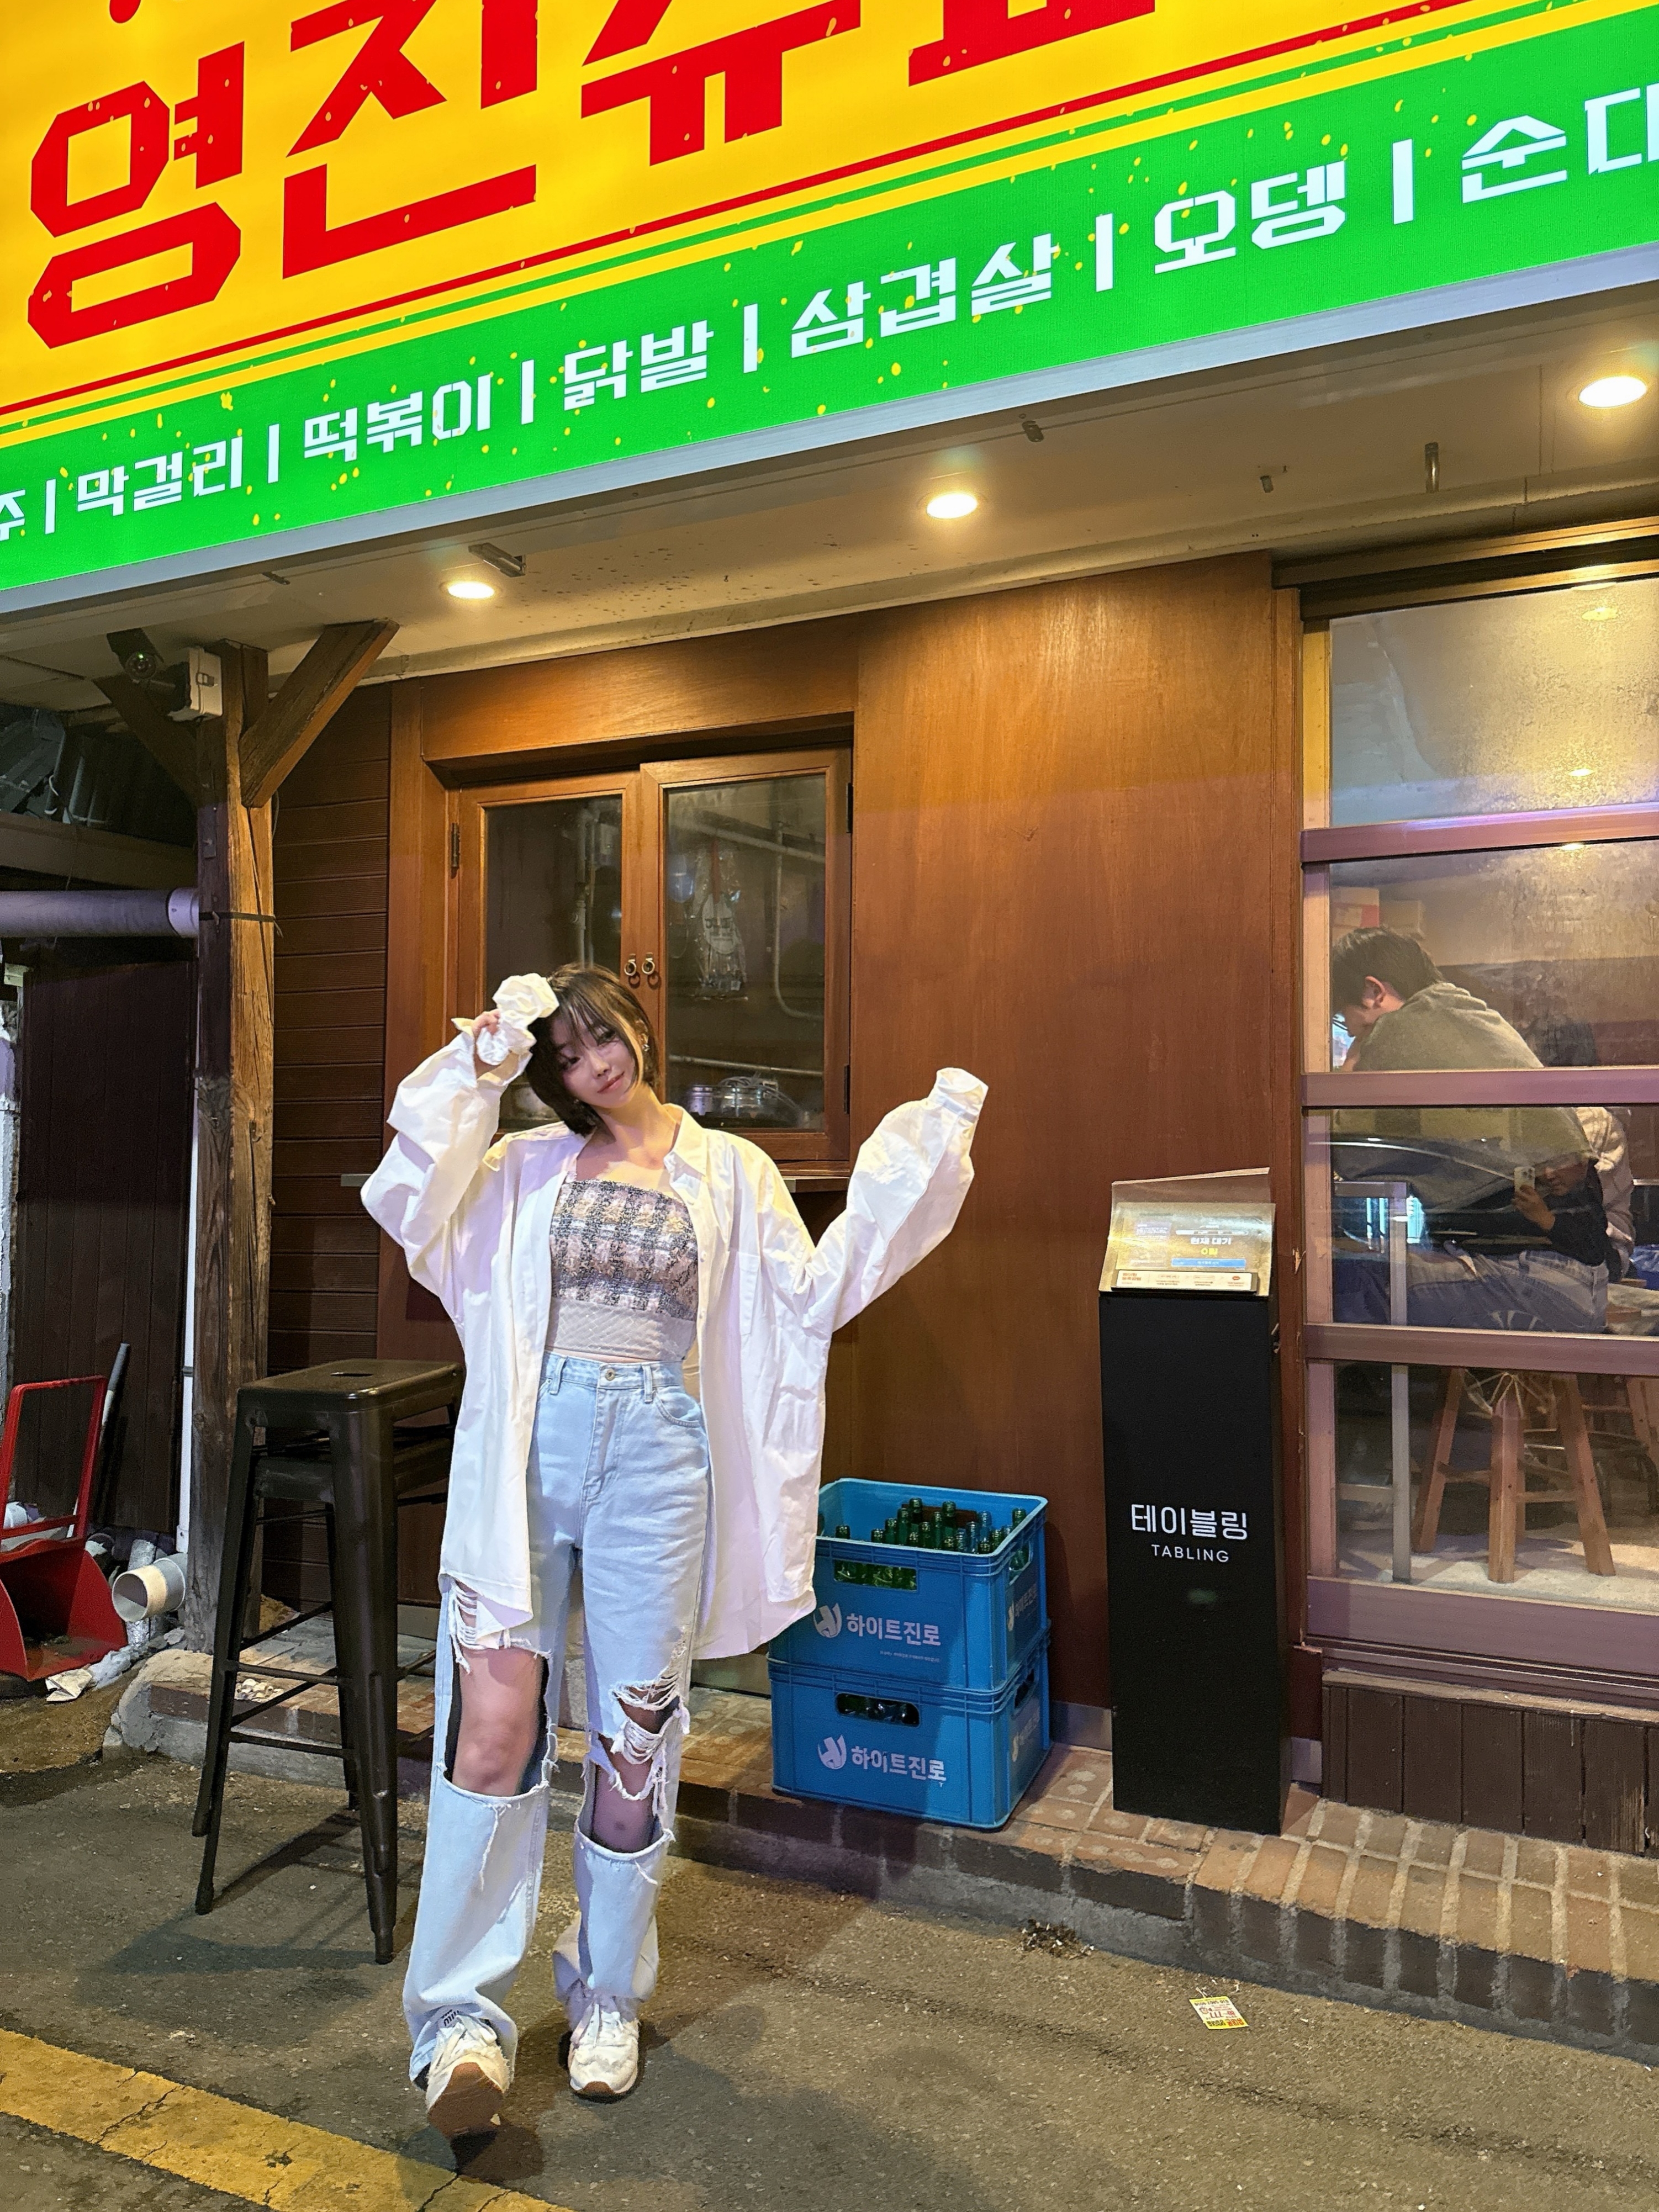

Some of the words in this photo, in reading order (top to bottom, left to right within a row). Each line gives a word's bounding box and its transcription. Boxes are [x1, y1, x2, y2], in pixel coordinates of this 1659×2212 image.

[77, 436, 244, 516] 막걸리
[304, 374, 492, 462] 떡볶이
[564, 320, 715, 411] 닭발
[791, 232, 1060, 359] 삼겹살
[1154, 160, 1346, 274] 오뎅
[1131, 1504, 1248, 1540] 테이블링
[1151, 1544, 1229, 1563] TABLING
[846, 1613, 941, 1646] 하이트진로
[851, 1745, 947, 1781] 하이트진로
